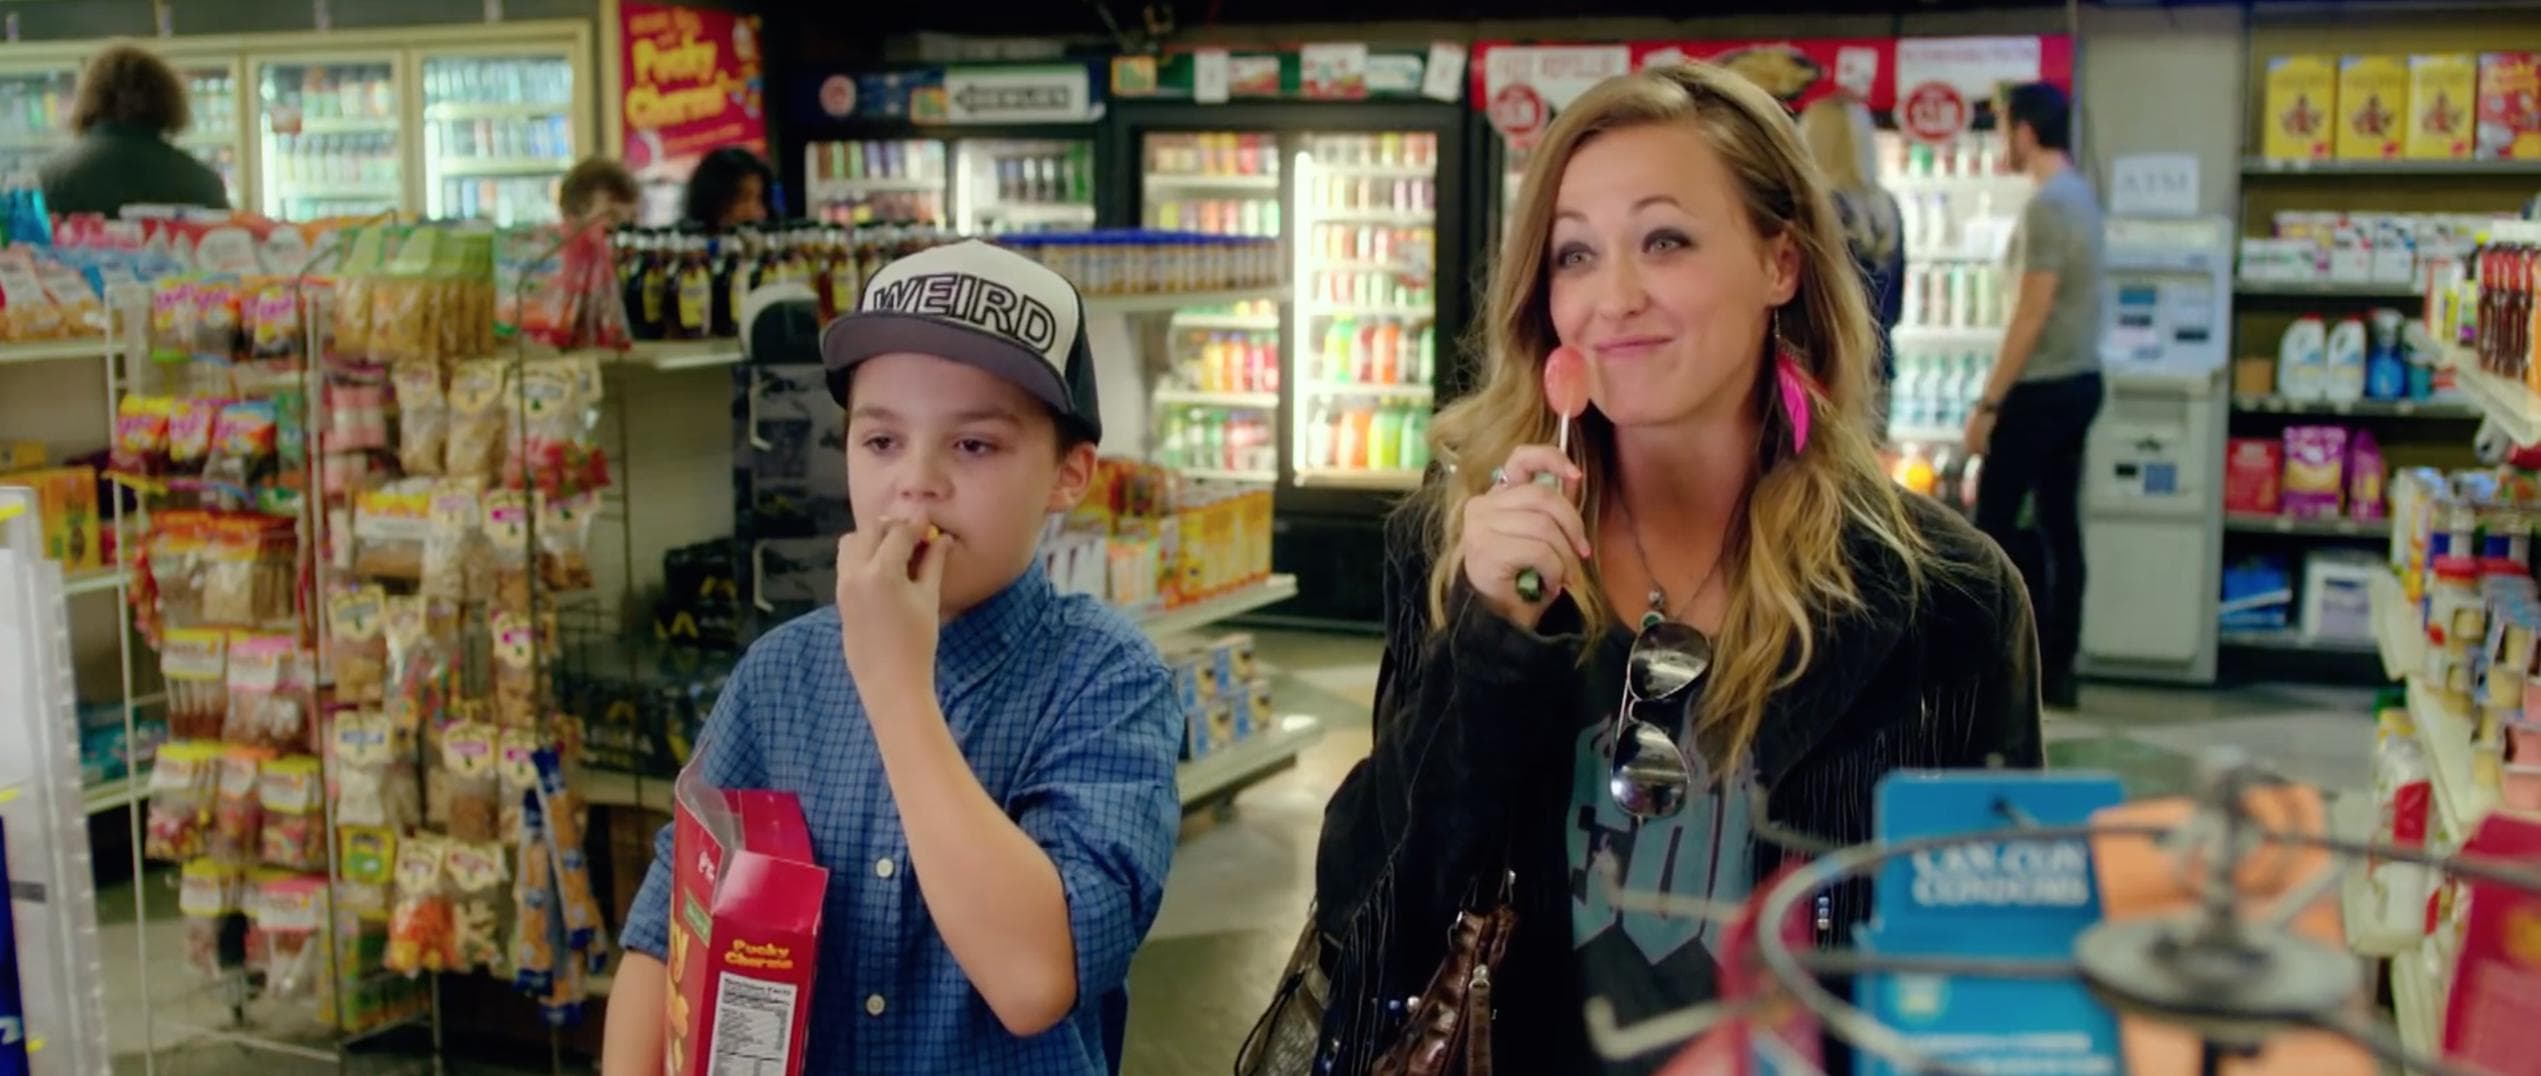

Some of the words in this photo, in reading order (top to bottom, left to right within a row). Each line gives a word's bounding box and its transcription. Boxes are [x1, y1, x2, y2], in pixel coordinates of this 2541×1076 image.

[873, 272, 1056, 354] WEIRD
[1912, 873, 2090, 906] CONDOMS
[724, 951, 794, 970] Charms
[733, 938, 790, 960] Pucky
